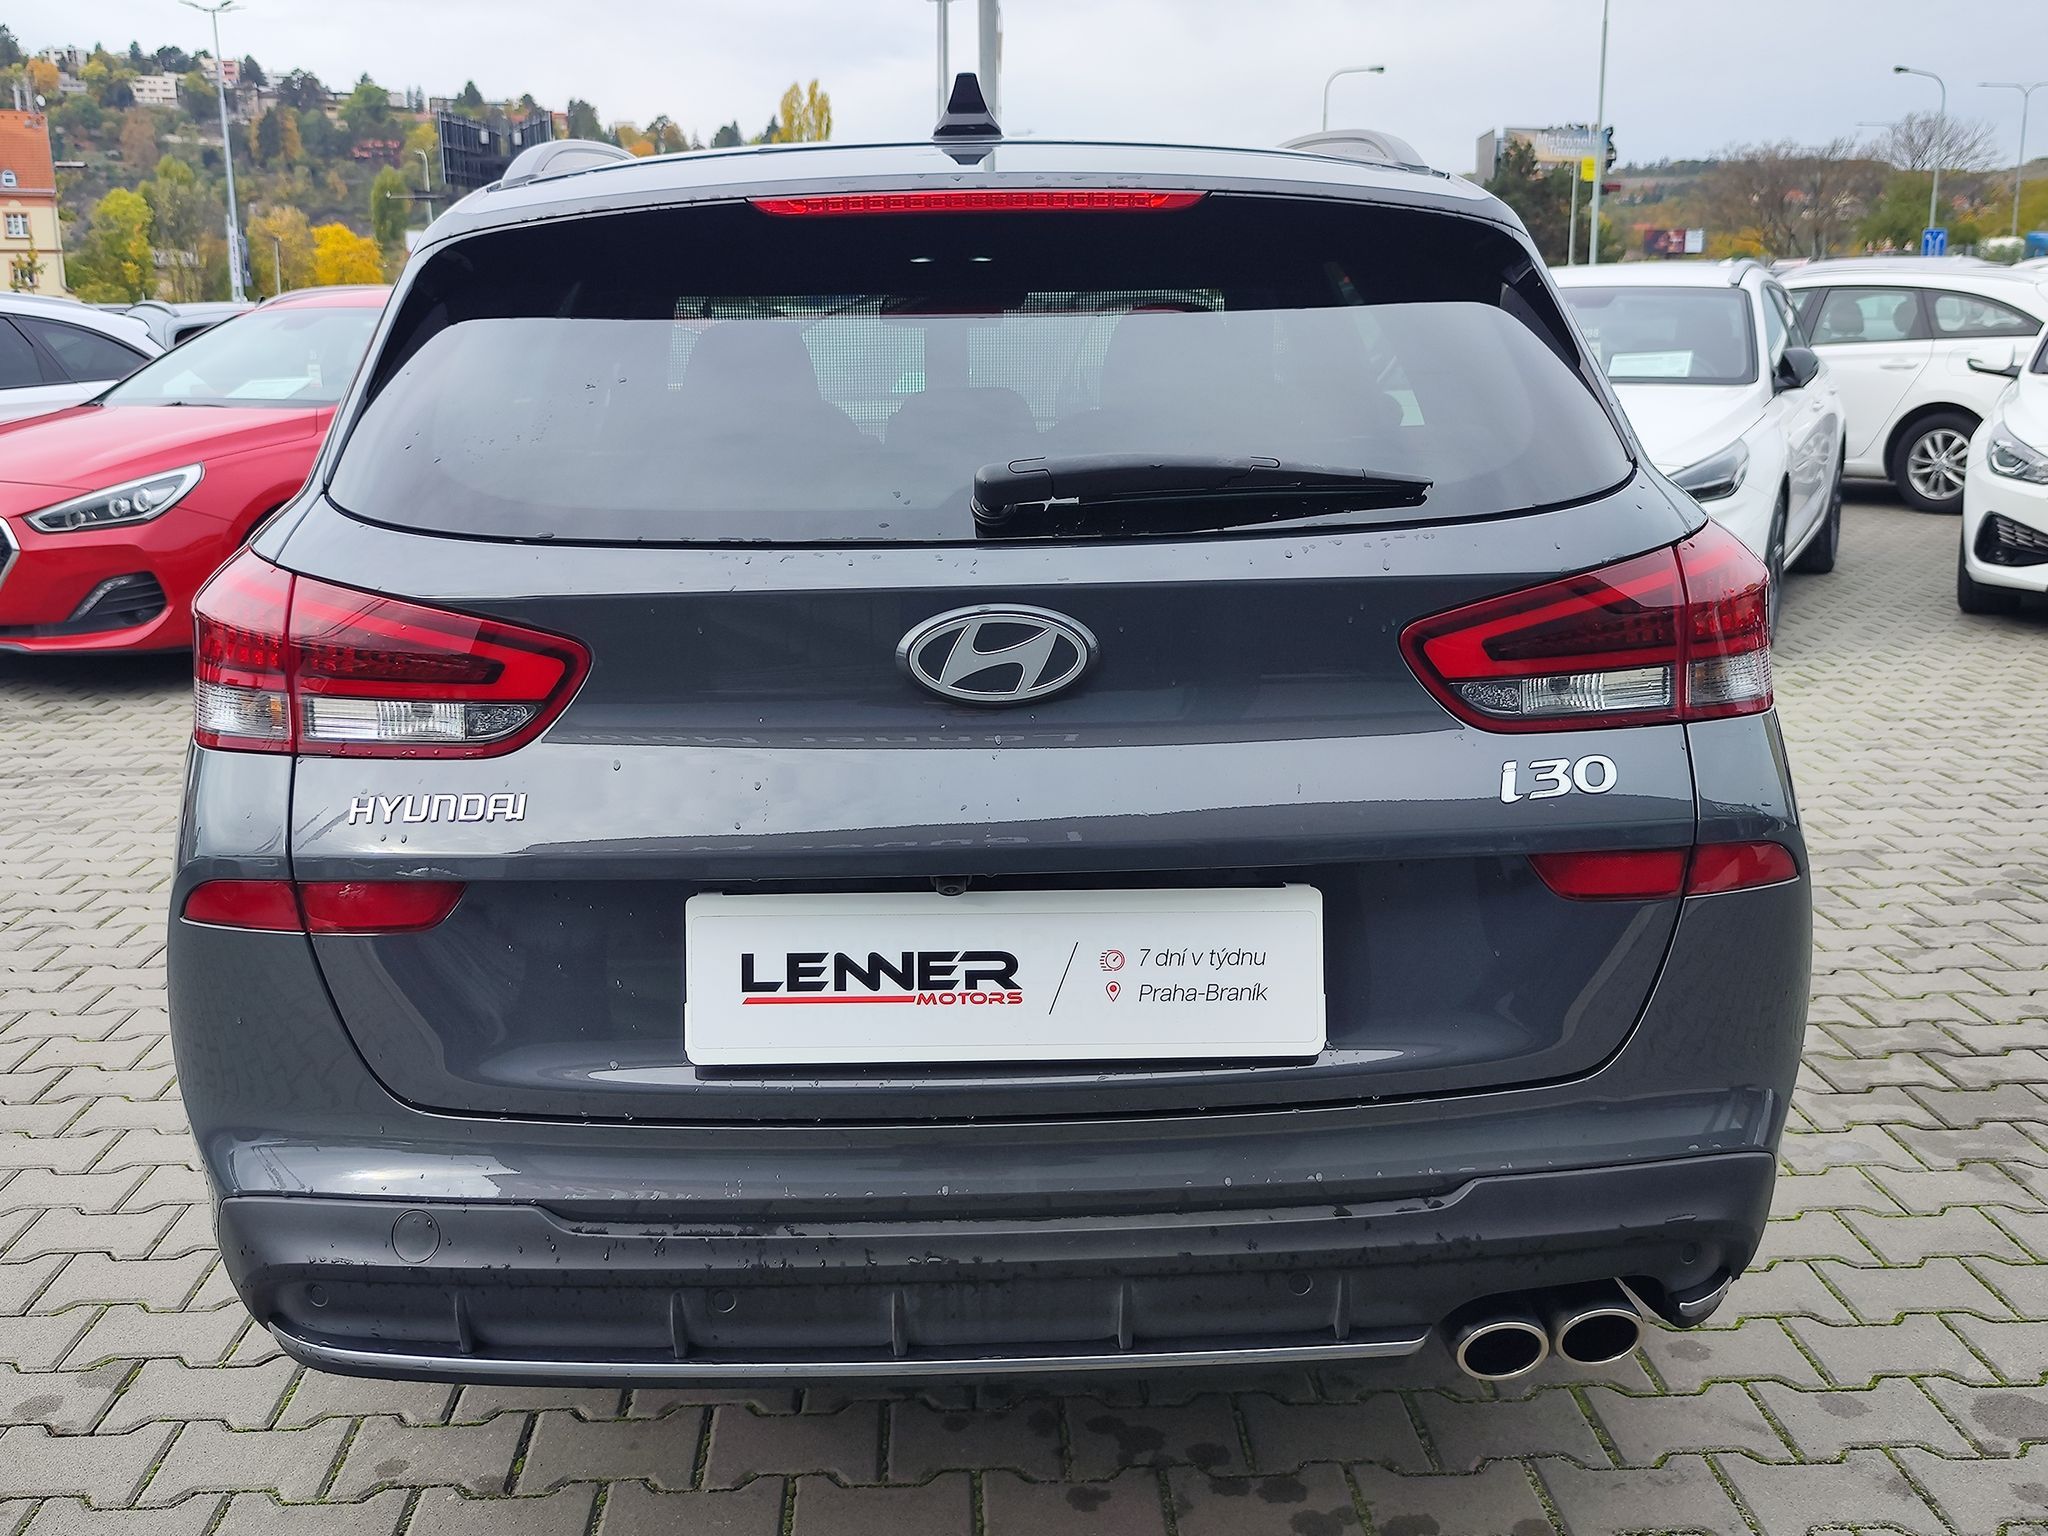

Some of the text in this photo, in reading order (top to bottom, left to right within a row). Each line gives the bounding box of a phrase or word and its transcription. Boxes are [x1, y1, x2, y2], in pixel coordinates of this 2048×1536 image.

[1500, 754, 1618, 804] i30
[348, 792, 528, 825] HYUNDAI
[741, 950, 1023, 993] LENNER
[1139, 947, 1267, 971] 7 dní v týdnu
[916, 992, 1023, 1006] MOTORS
[1138, 982, 1269, 1002] Praha-Braník
